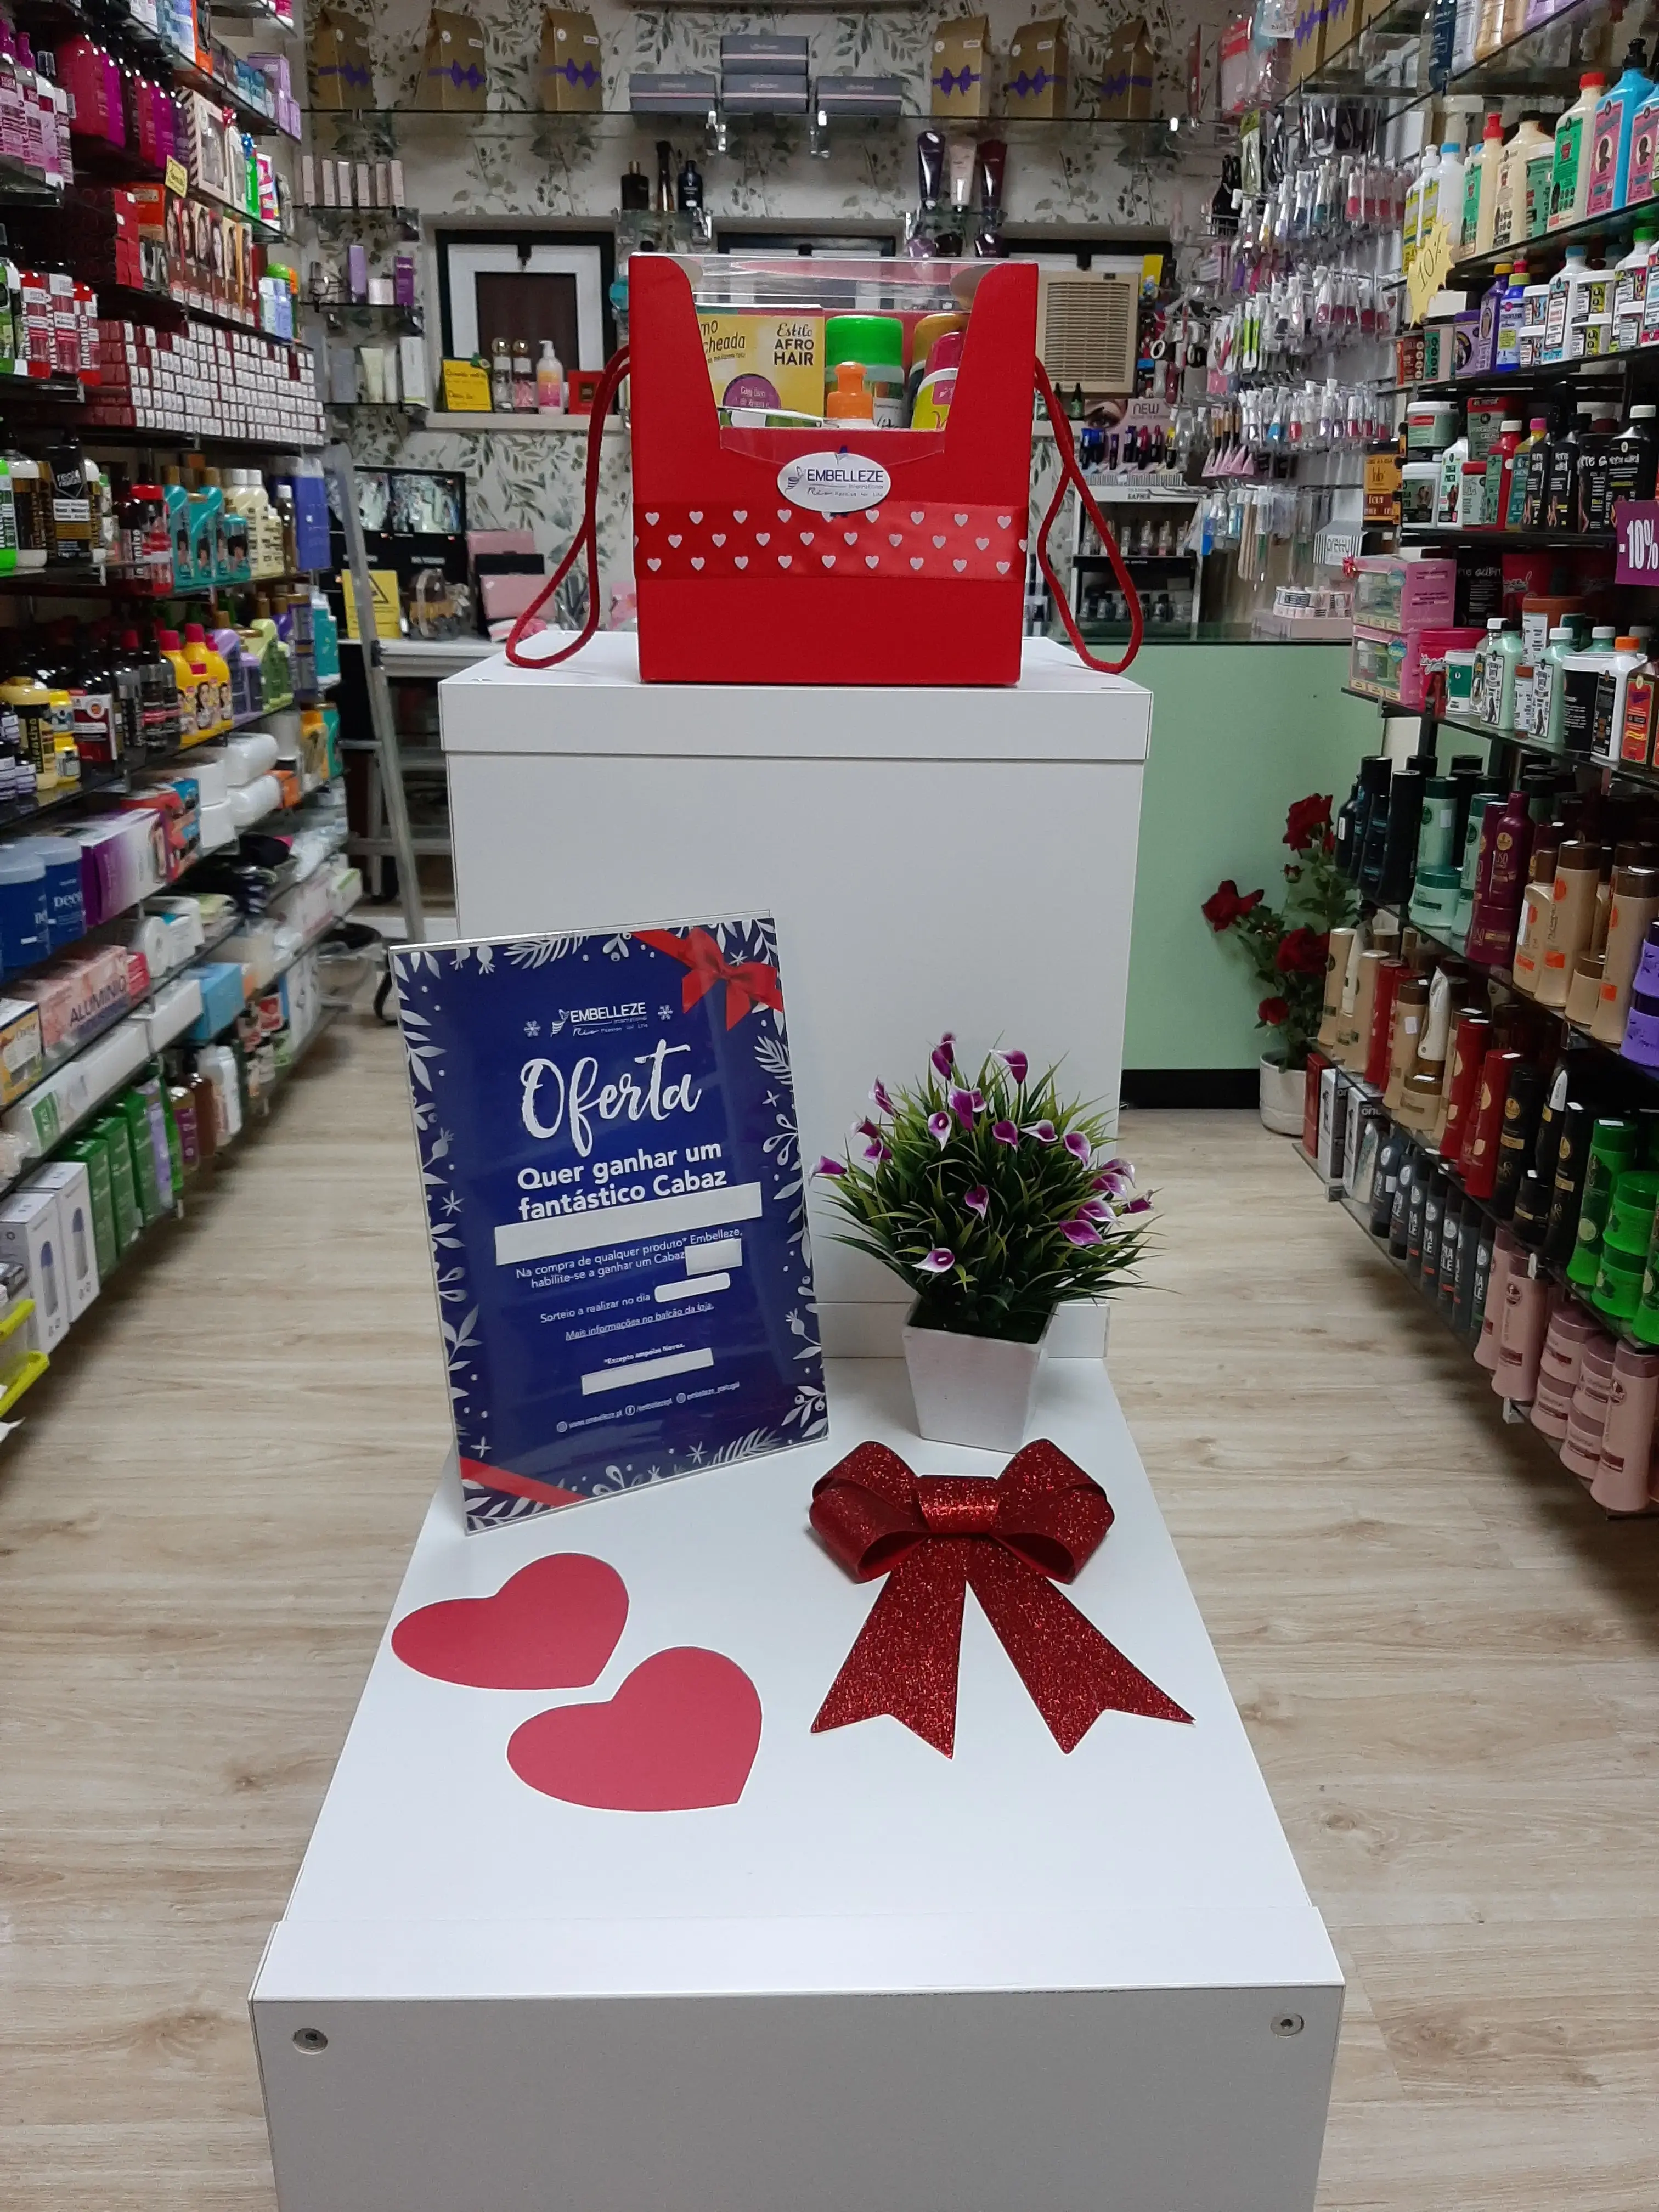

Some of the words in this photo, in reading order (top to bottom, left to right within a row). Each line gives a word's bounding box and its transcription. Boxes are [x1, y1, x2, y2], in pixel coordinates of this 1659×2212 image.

[775, 338, 814, 351] AFRO
[776, 322, 812, 337] Estilo
[774, 352, 814, 366] HAIR
[807, 469, 884, 483] EMBELLEZE
[570, 1002, 647, 1023] EMBELLEZE
[520, 1039, 702, 1158] Oferta
[517, 1165, 584, 1190] Quer
[592, 1148, 678, 1184] ganhar
[685, 1143, 722, 1163] um
[518, 1183, 646, 1221] fantástico
[653, 1170, 727, 1197] Cabaz
[516, 1268, 532, 1279] Na
[535, 1261, 575, 1274] compra
[578, 1255, 591, 1267] de
[594, 1249, 640, 1265] qualquer
[531, 1271, 586, 1289] habilite-se
[597, 1261, 633, 1278] ganhar
[636, 1257, 652, 1268] um
[654, 1251, 686, 1264] Cabaz
[540, 1308, 576, 1323] Sorteio
[586, 1300, 619, 1314] realizar
[622, 1297, 634, 1306] no
[636, 1293, 651, 1303] dia
[565, 1328, 586, 1340] Mais
[588, 1318, 641, 1336] informações
[642, 1316, 654, 1324] no
[656, 1308, 683, 1321] balcão
[685, 1305, 696, 1314] da
